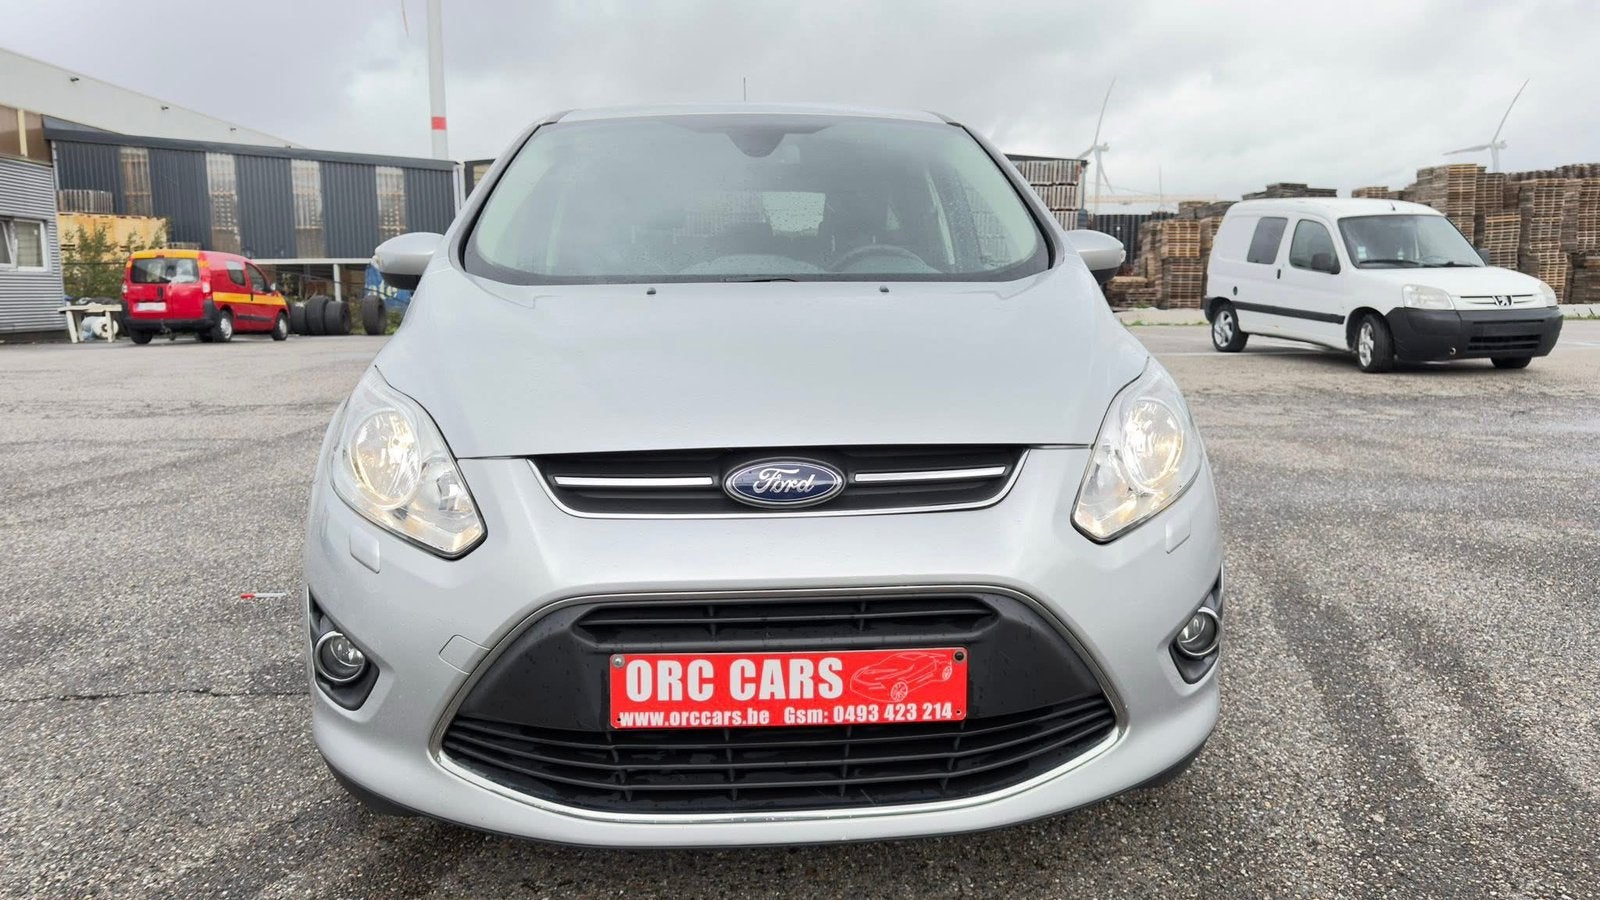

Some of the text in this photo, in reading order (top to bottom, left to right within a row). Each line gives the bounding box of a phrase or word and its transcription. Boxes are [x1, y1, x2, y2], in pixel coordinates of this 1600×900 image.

[752, 467, 816, 494] Ford
[625, 656, 844, 702] ORC CARS
[619, 702, 953, 727] www.orccars.be Gsm: 0493 423 214
